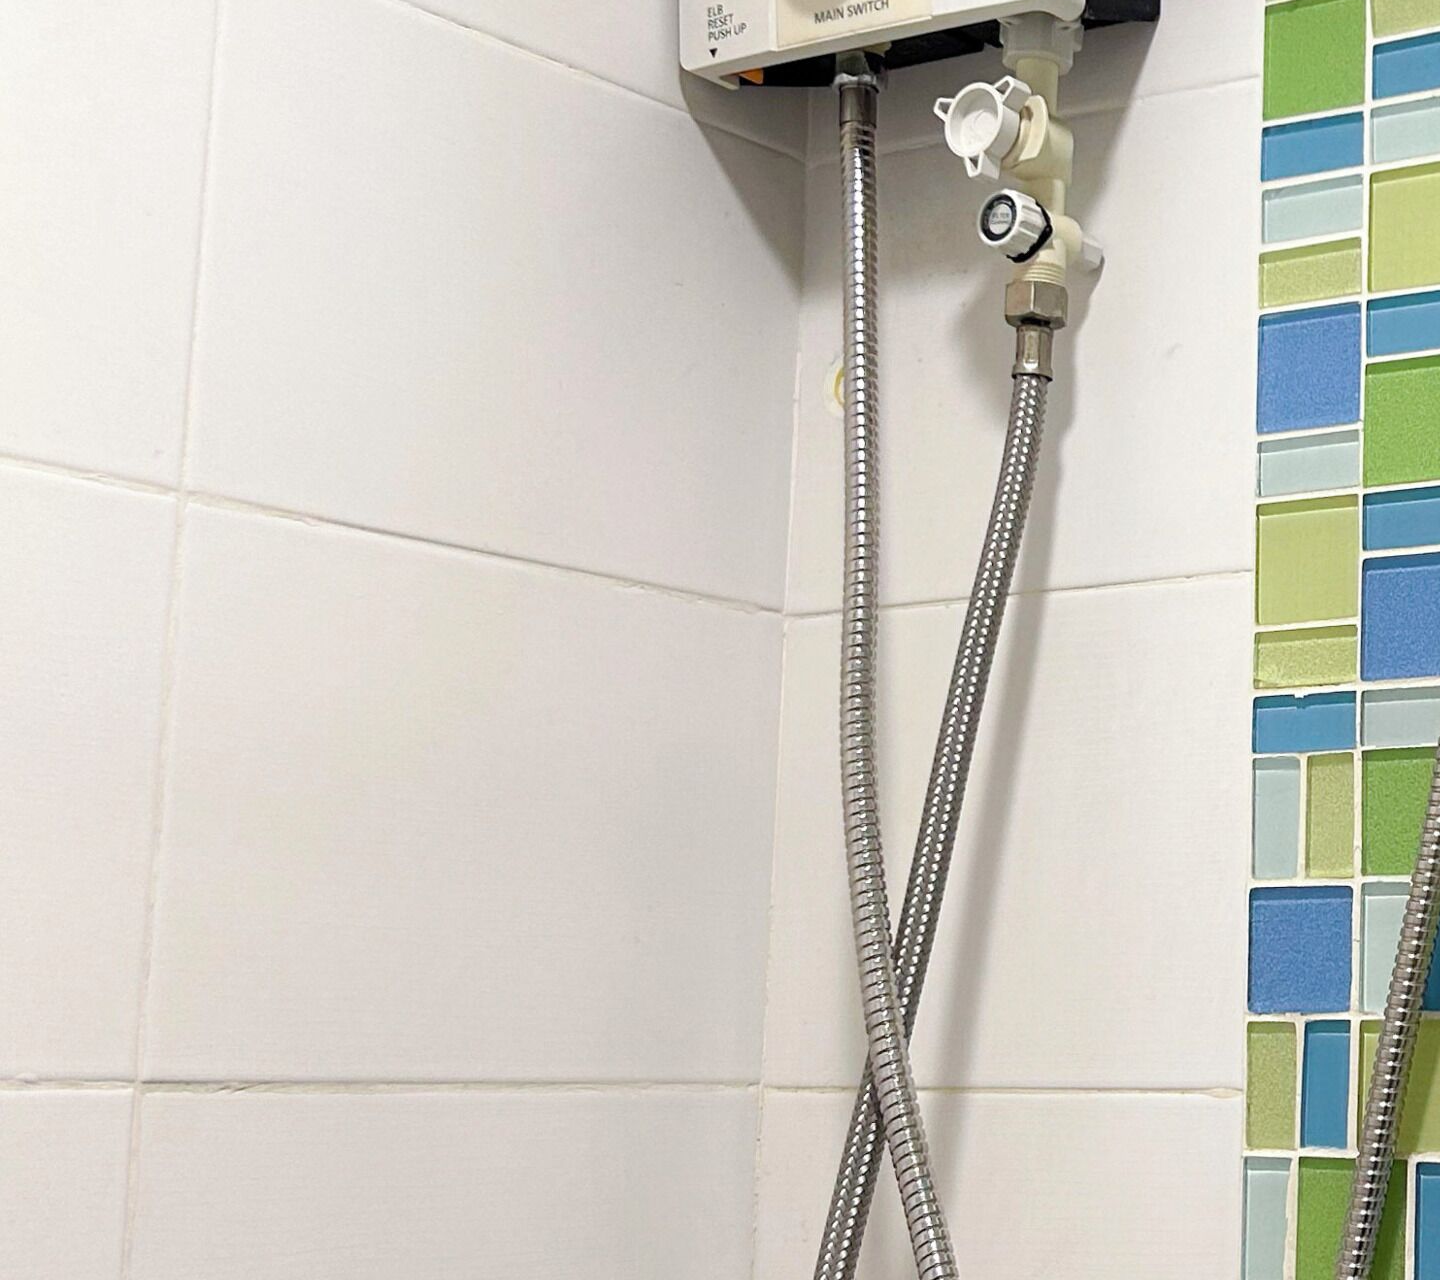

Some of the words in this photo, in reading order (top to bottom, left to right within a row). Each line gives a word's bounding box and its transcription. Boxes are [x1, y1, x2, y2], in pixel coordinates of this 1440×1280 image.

[707, 4, 724, 18] ELB
[814, 8, 846, 25] MAIN
[707, 13, 734, 31] RESET
[707, 28, 732, 43] PUSH
[733, 22, 748, 36] UP
